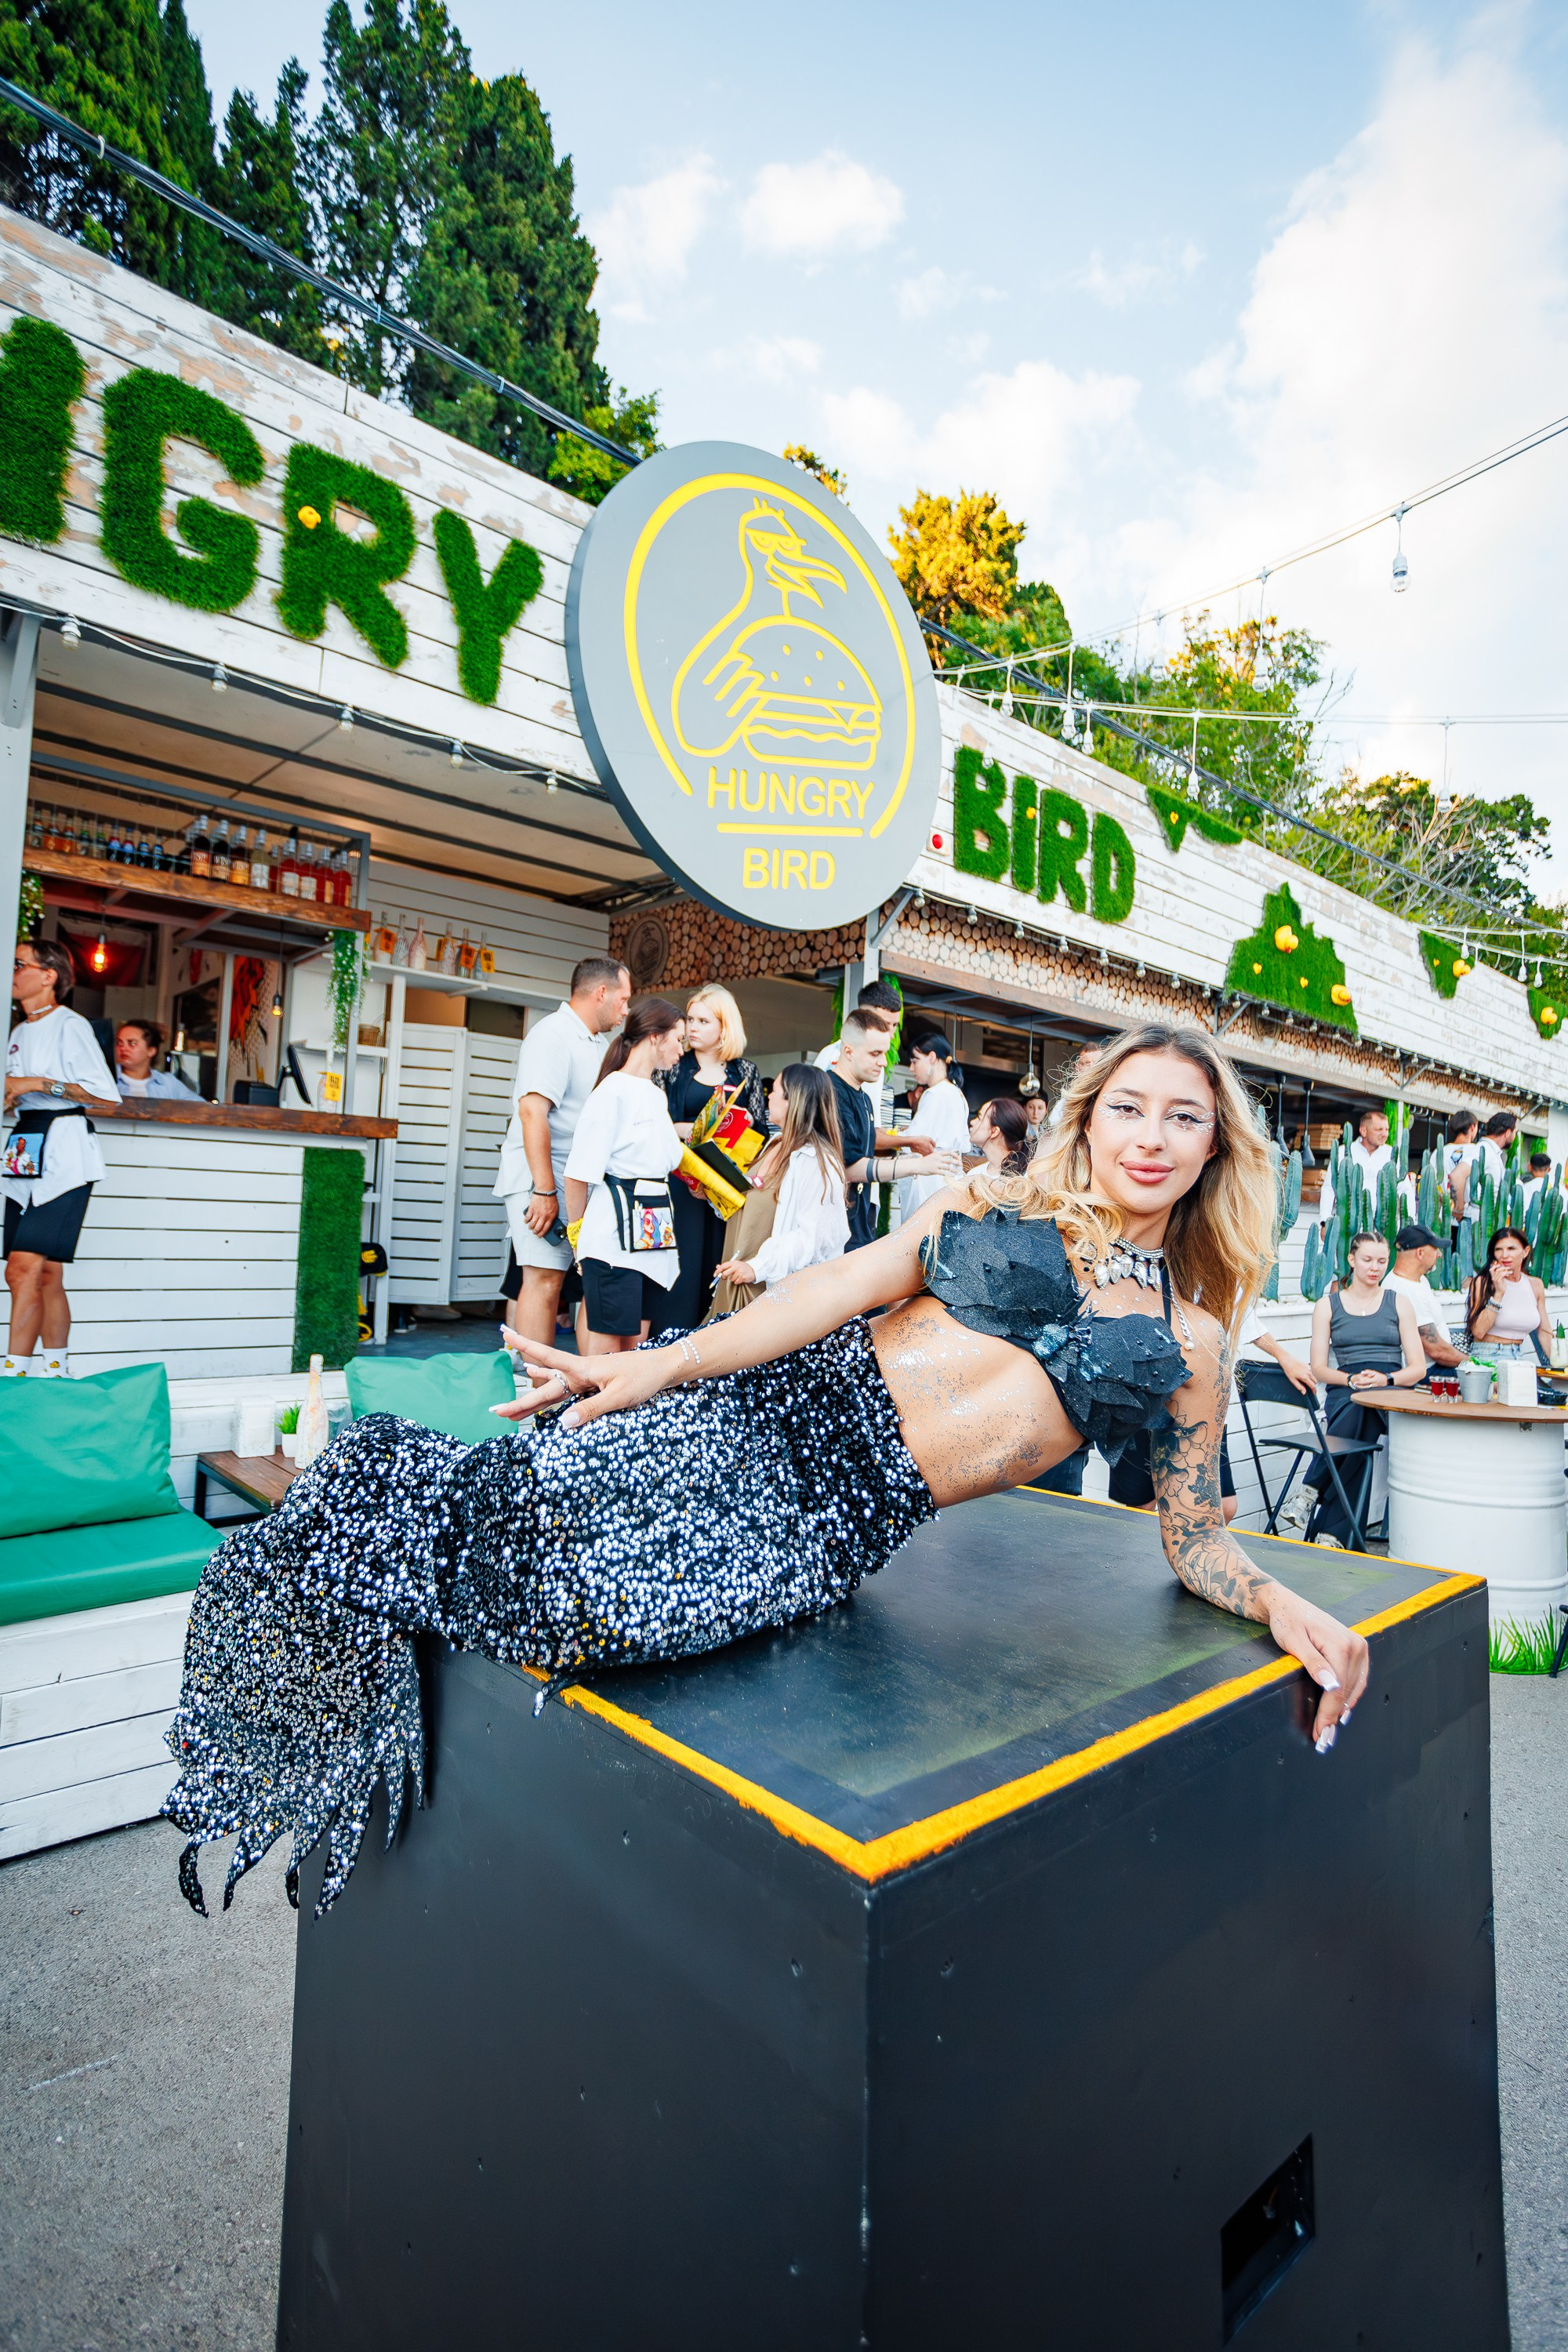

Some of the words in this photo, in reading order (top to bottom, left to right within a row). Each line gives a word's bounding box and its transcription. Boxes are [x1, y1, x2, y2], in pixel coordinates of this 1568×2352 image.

[707, 765, 875, 820] HUNGRY
[953, 745, 1135, 924] BIRD
[742, 847, 836, 891] BIRD
